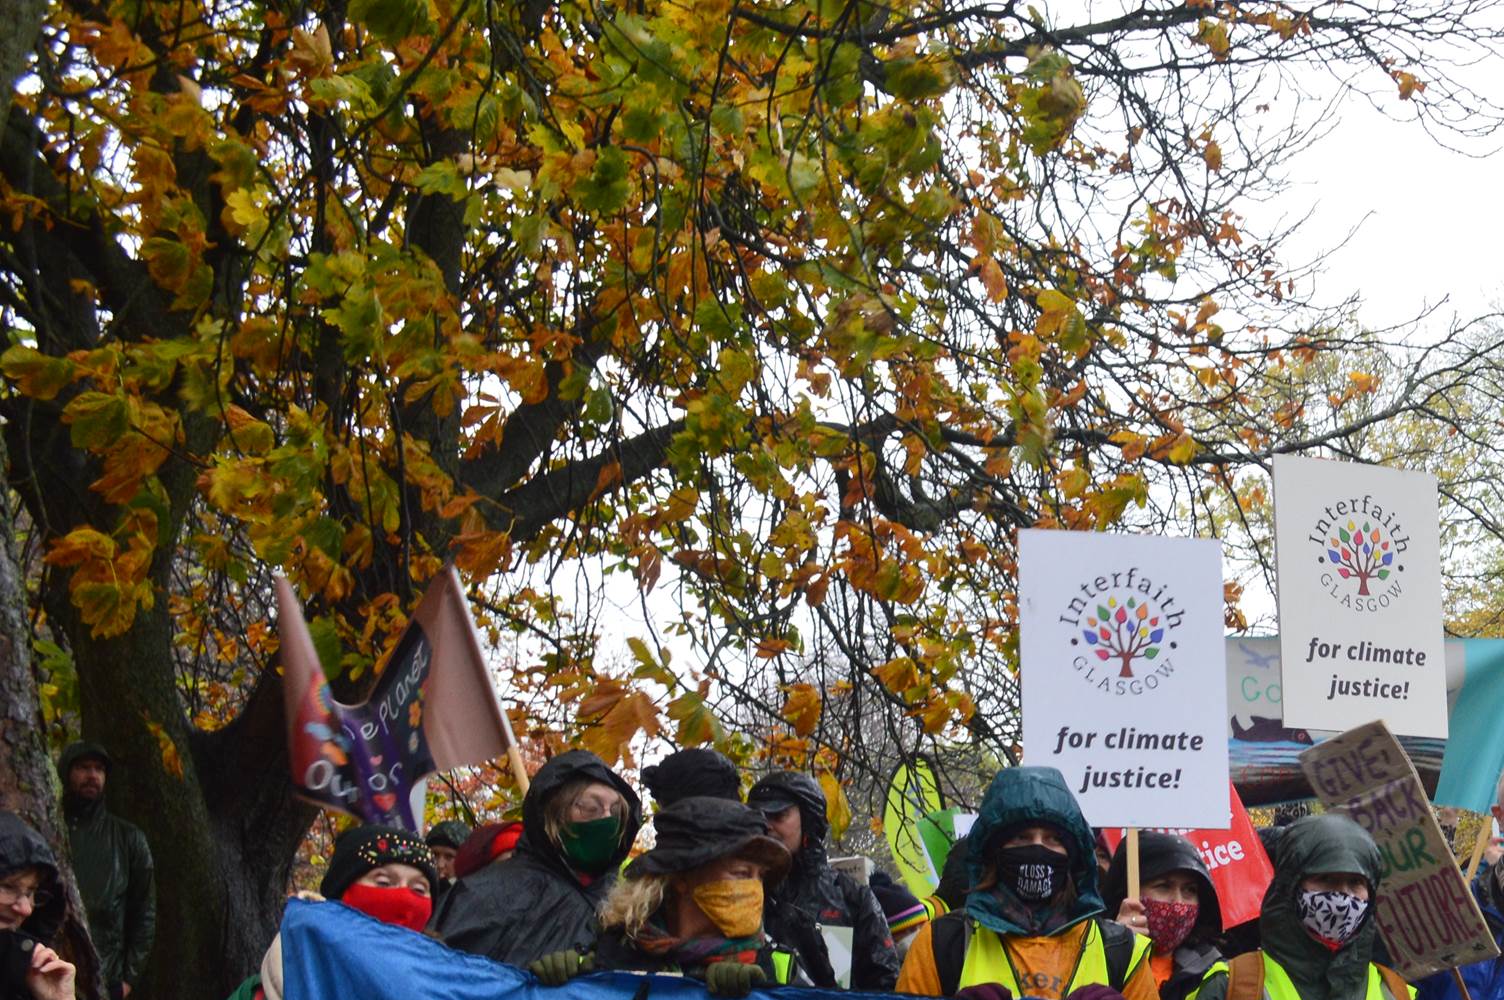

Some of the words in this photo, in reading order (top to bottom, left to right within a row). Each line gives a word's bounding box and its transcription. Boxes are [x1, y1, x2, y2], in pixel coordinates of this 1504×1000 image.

[1308, 495, 1410, 553] Interfaith
[1060, 567, 1185, 629] Interfaith
[1320, 573, 1402, 612] GLASGOW
[1306, 637, 1341, 662] for
[1347, 641, 1426, 666] climate
[1072, 656, 1176, 696] GLASGOW
[1327, 674, 1410, 700] justice!
[1053, 726, 1098, 754] for
[1104, 727, 1204, 751] climate
[1078, 765, 1182, 794] justice!
[1348, 776, 1429, 833] BACK
